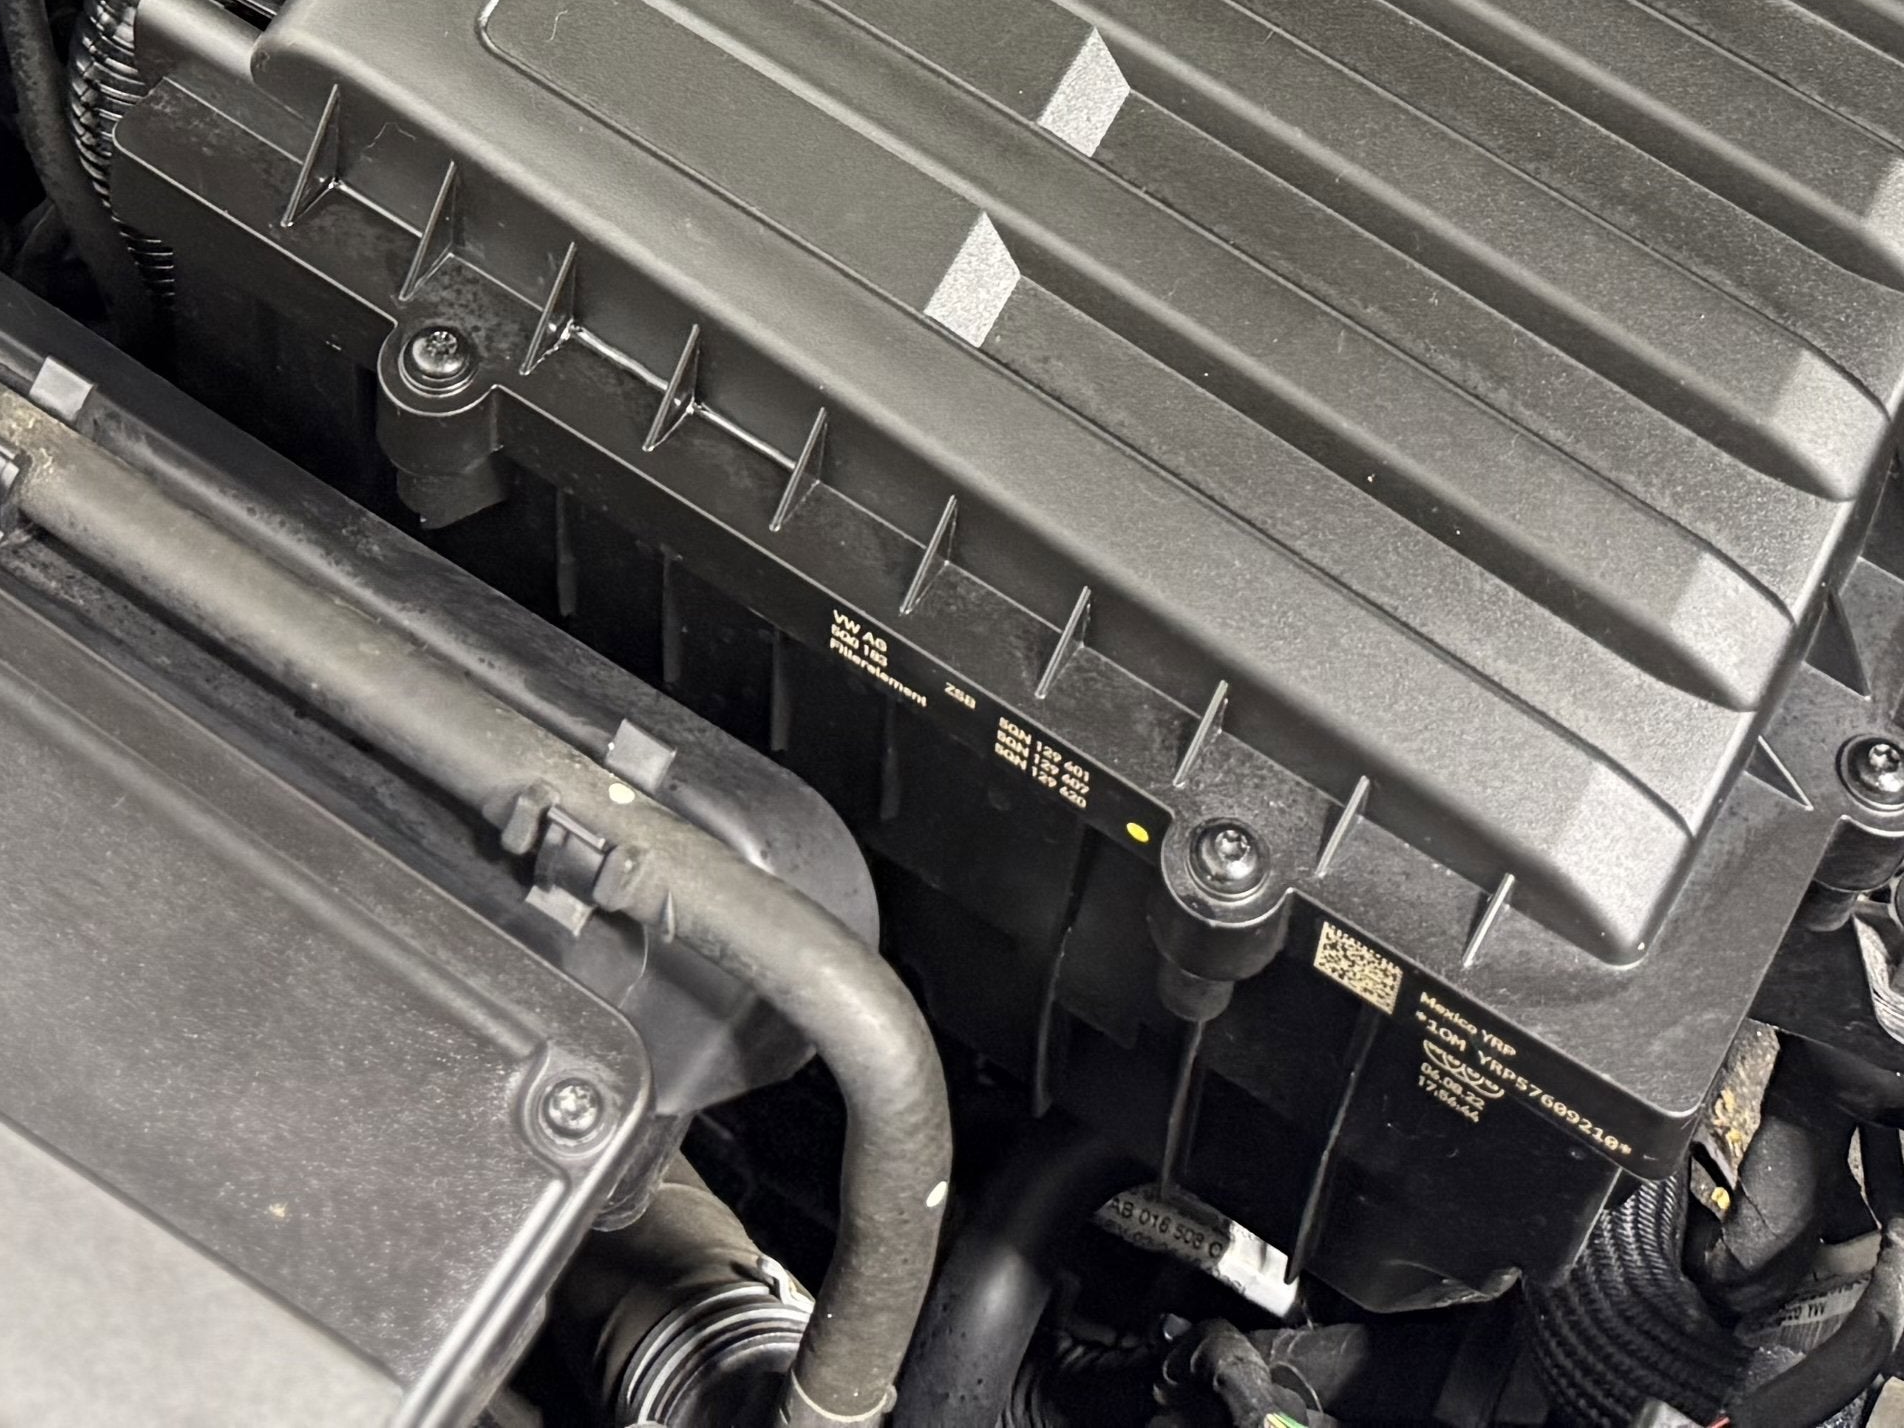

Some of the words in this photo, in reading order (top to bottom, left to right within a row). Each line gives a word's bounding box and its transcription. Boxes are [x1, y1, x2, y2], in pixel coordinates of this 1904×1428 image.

[828, 609, 861, 635] VW
[861, 629, 890, 653] AG
[1030, 752, 1061, 777] 129
[1059, 771, 1090, 796] 607
[1032, 739, 1063, 764] 129
[1061, 758, 1093, 783] 601
[1028, 765, 1059, 790] 129
[1057, 783, 1088, 809] 620
[1416, 991, 1481, 1036] Mexico
[1476, 1028, 1518, 1059] YRP
